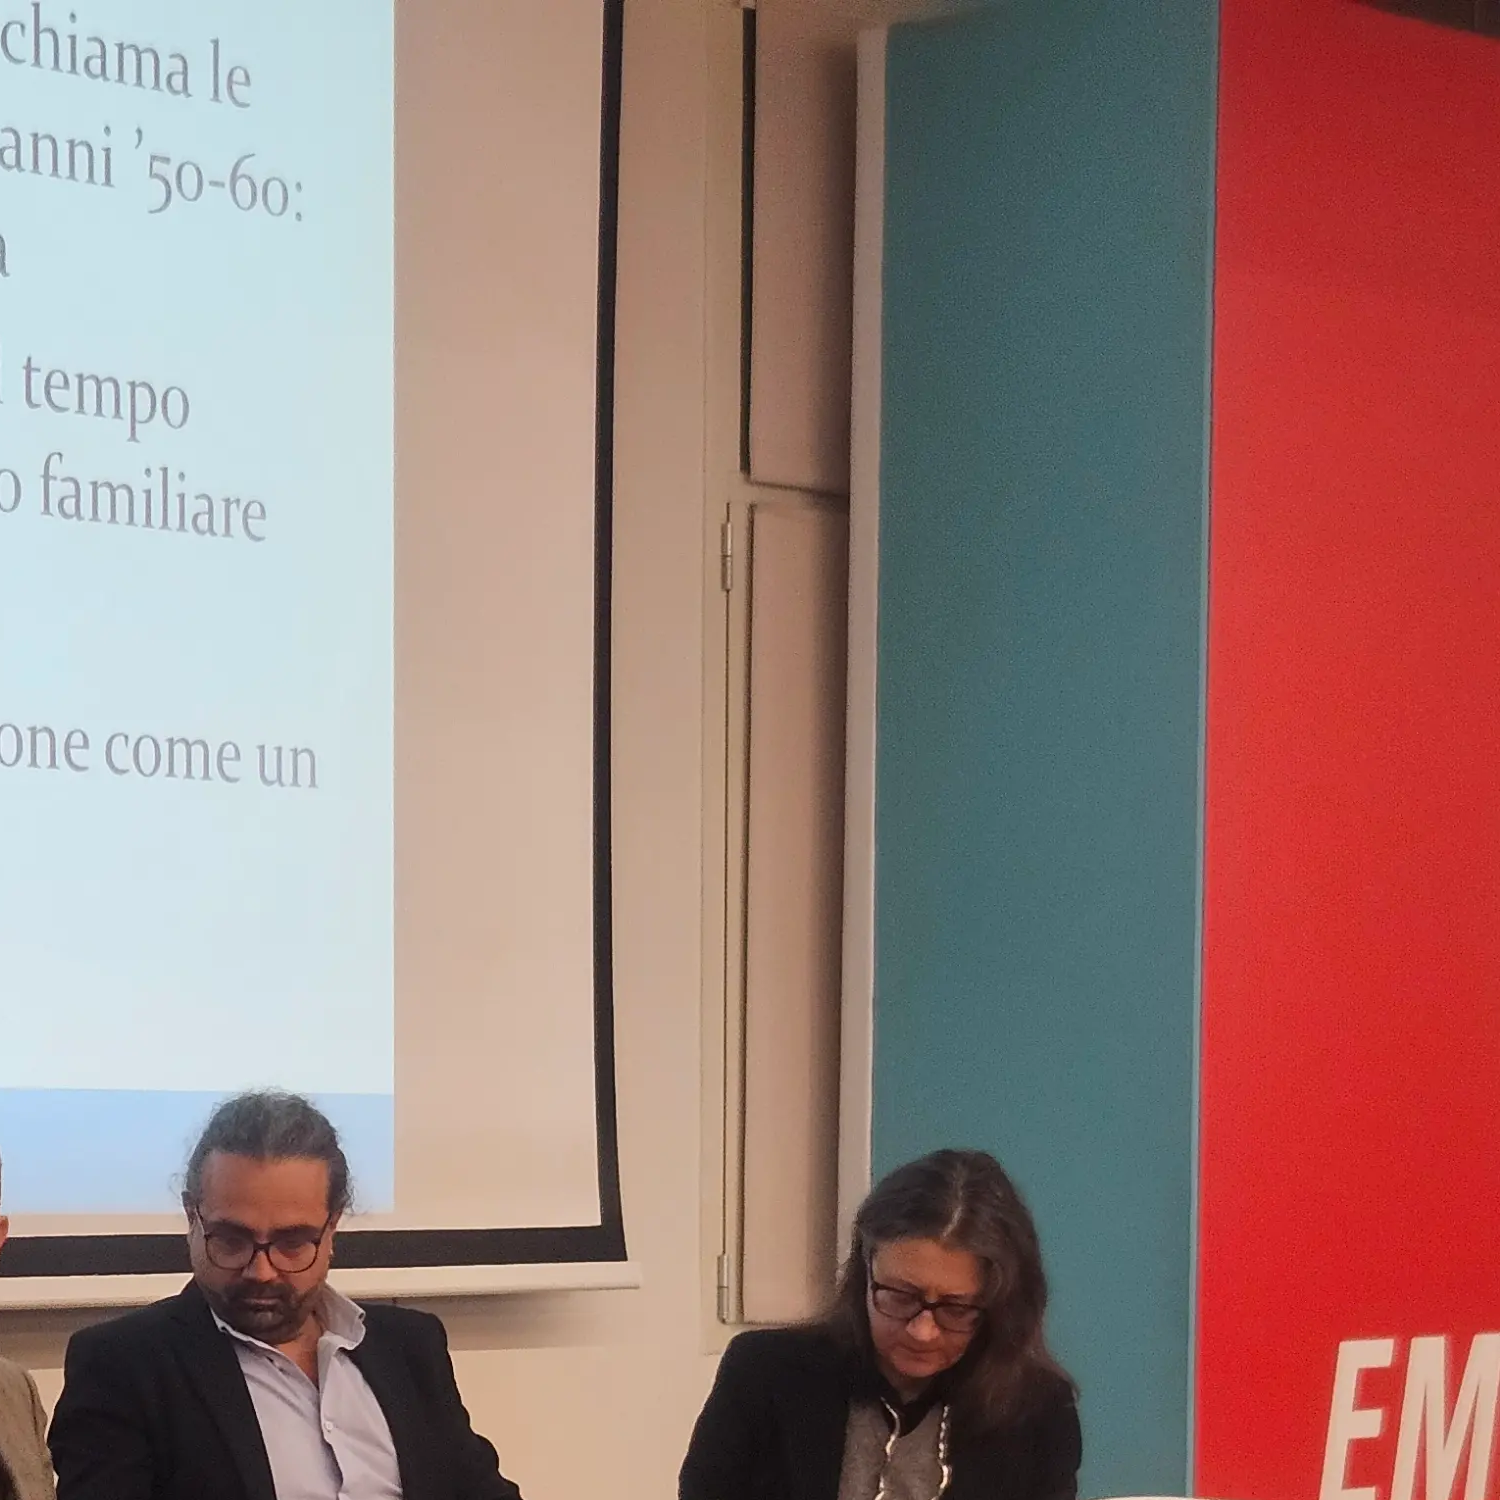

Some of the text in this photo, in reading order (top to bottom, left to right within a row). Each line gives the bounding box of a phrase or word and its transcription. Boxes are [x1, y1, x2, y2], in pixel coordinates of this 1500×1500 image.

[209, 36, 252, 109] le
[21, 355, 190, 444] tempo
[39, 451, 267, 543] familiare
[104, 731, 242, 784] come
[256, 743, 319, 789] un
